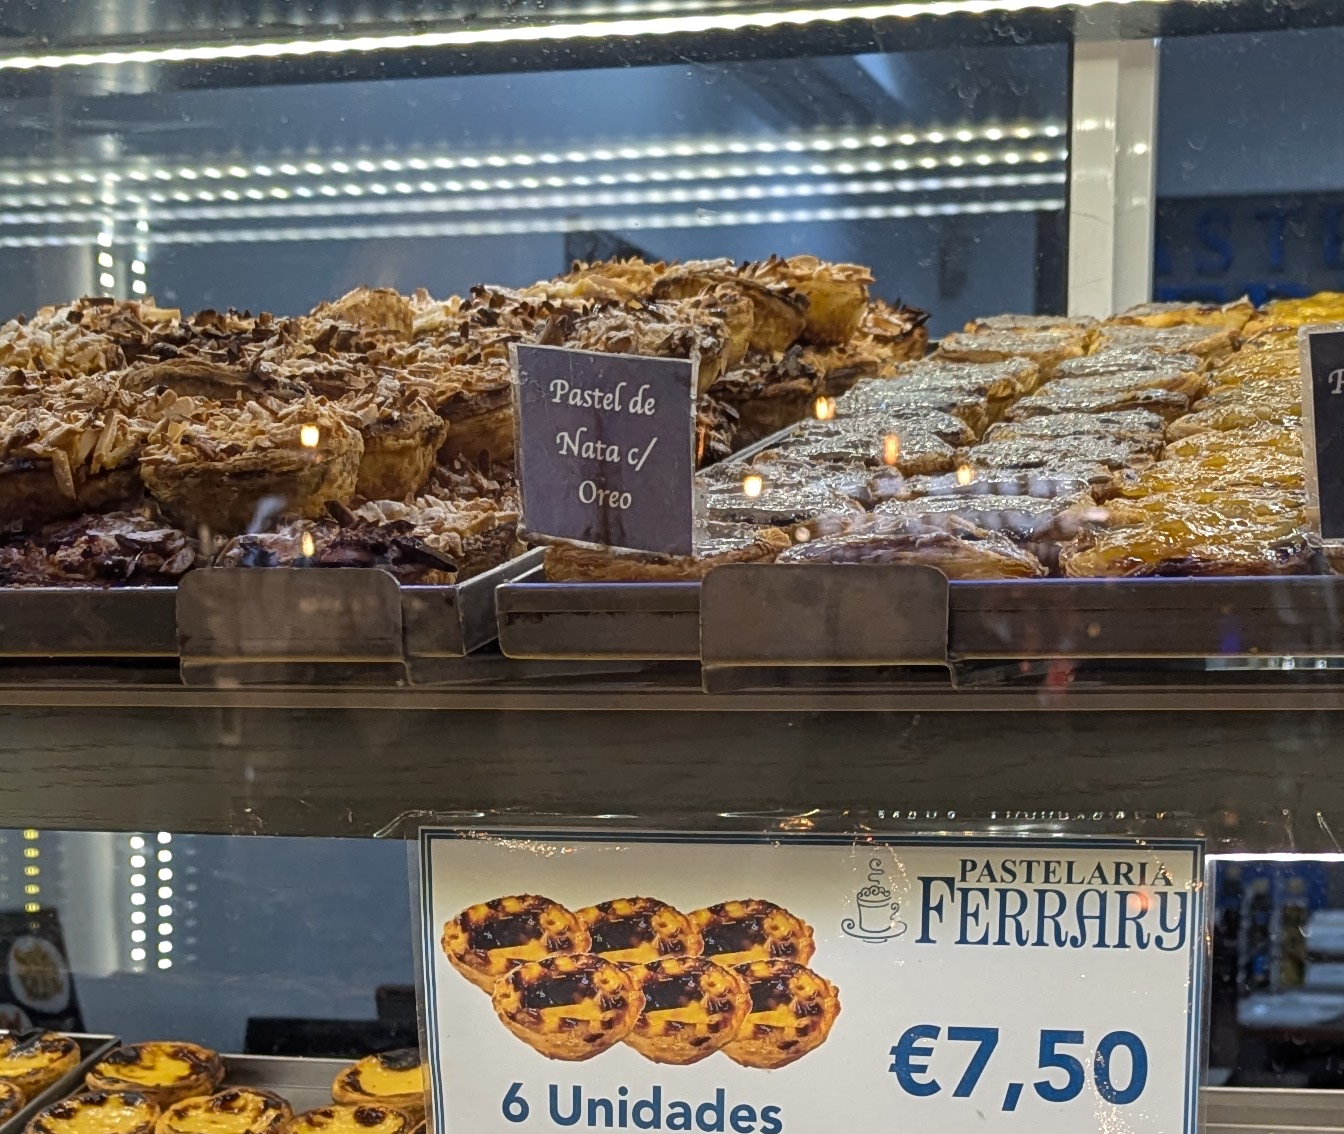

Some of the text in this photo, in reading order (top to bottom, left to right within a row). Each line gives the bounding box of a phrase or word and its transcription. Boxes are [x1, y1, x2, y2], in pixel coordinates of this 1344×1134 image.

[549, 379, 656, 416] Pastel de
[556, 427, 658, 471] Nata c/
[578, 480, 632, 510] Oreo
[957, 859, 1174, 887] PASTELARIA
[914, 876, 1189, 951] FERRARY
[889, 1023, 1148, 1112] €7,50
[501, 1082, 529, 1123] 6
